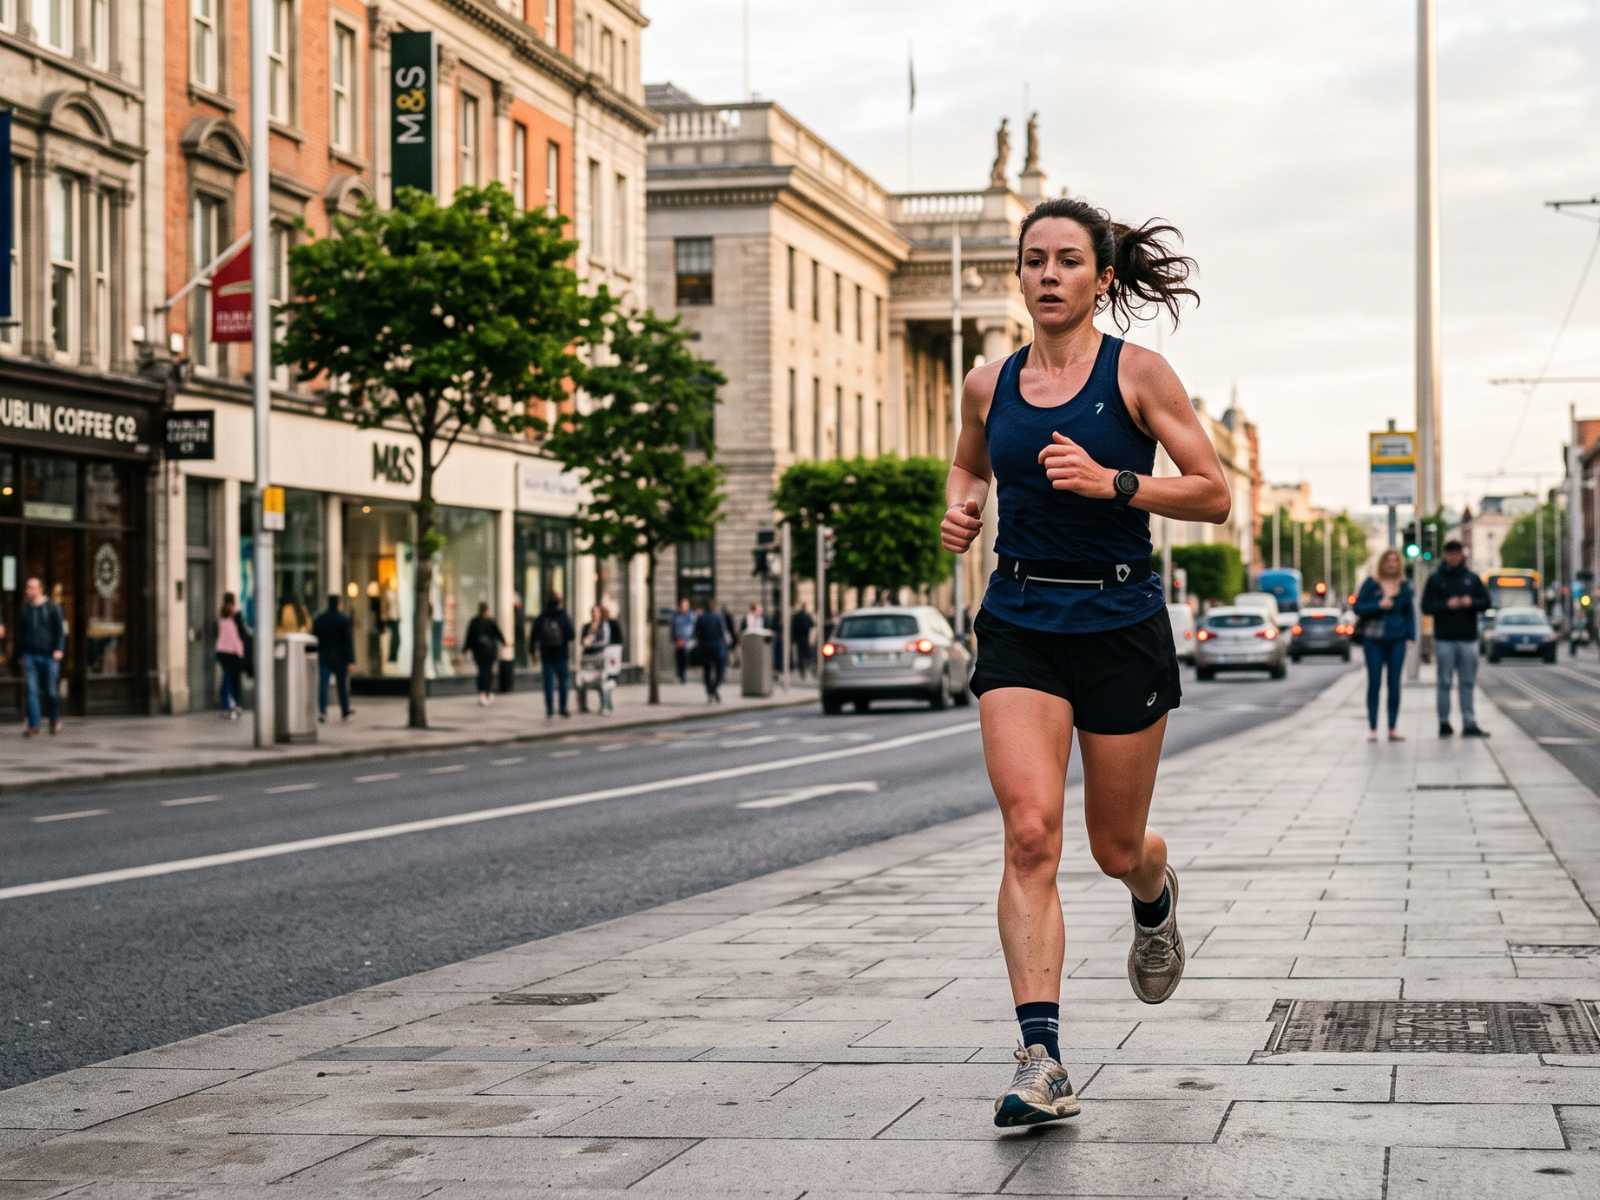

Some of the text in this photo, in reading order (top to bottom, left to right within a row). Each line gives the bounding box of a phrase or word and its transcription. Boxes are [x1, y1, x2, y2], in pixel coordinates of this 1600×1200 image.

[395, 65, 426, 143] M&S
[0, 397, 51, 431] UBLIN
[54, 406, 113, 440] COFFEE
[373, 442, 415, 485] M&S
